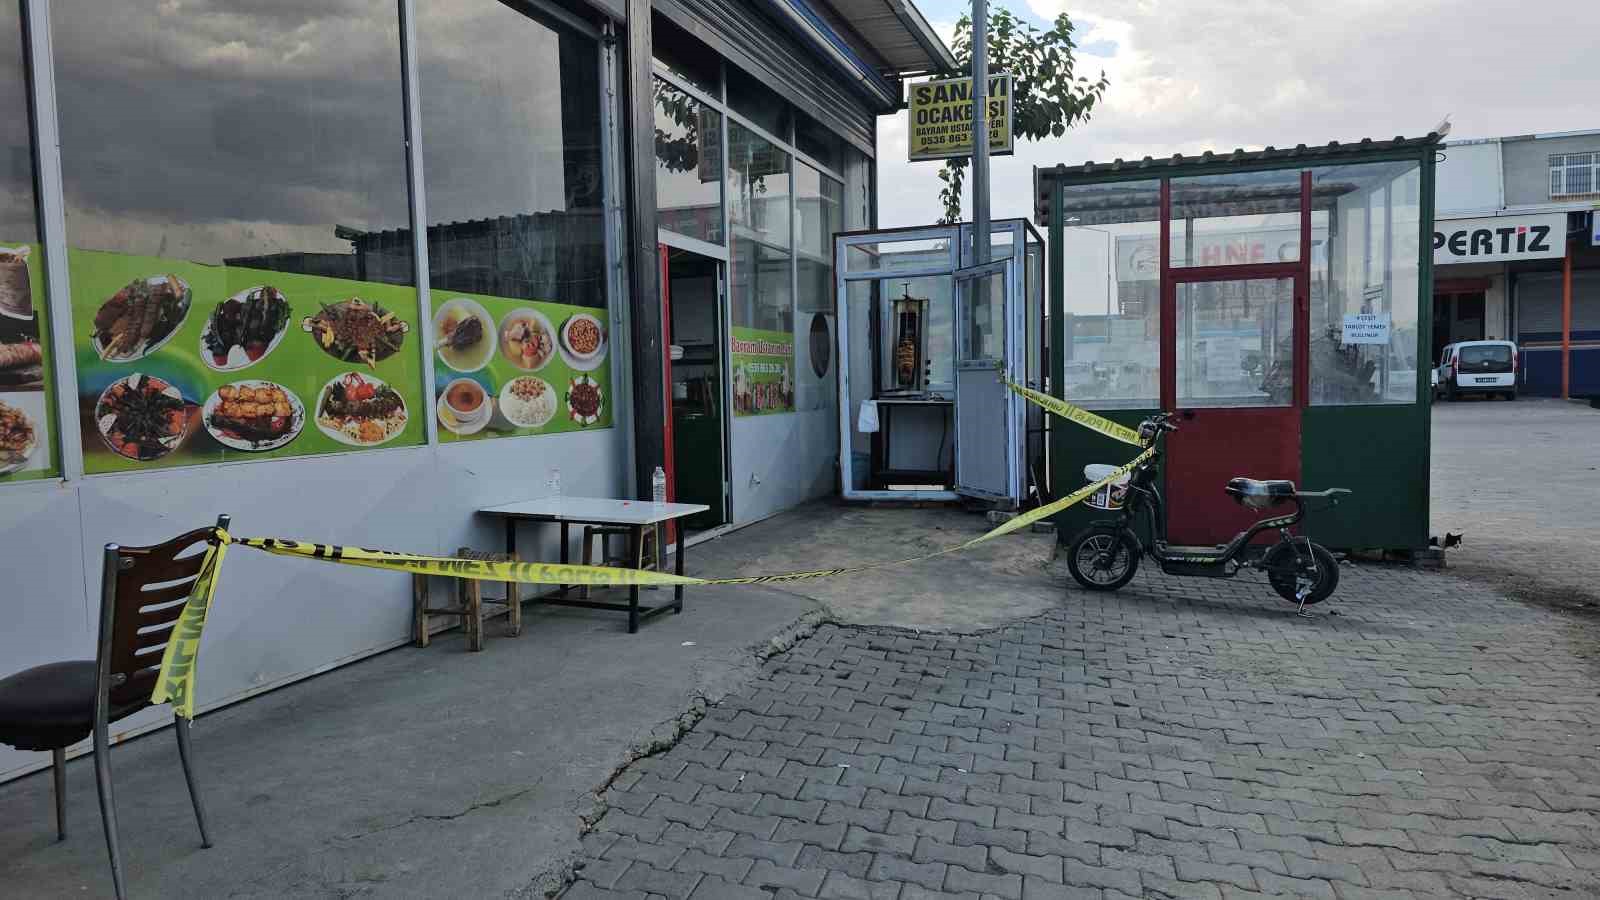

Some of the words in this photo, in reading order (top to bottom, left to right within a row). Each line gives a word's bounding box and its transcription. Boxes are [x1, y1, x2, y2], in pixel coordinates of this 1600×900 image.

[916, 79, 1007, 105] SANYI
[917, 100, 1005, 125] OCAKBŞI
[916, 126, 949, 136] BAYRAM
